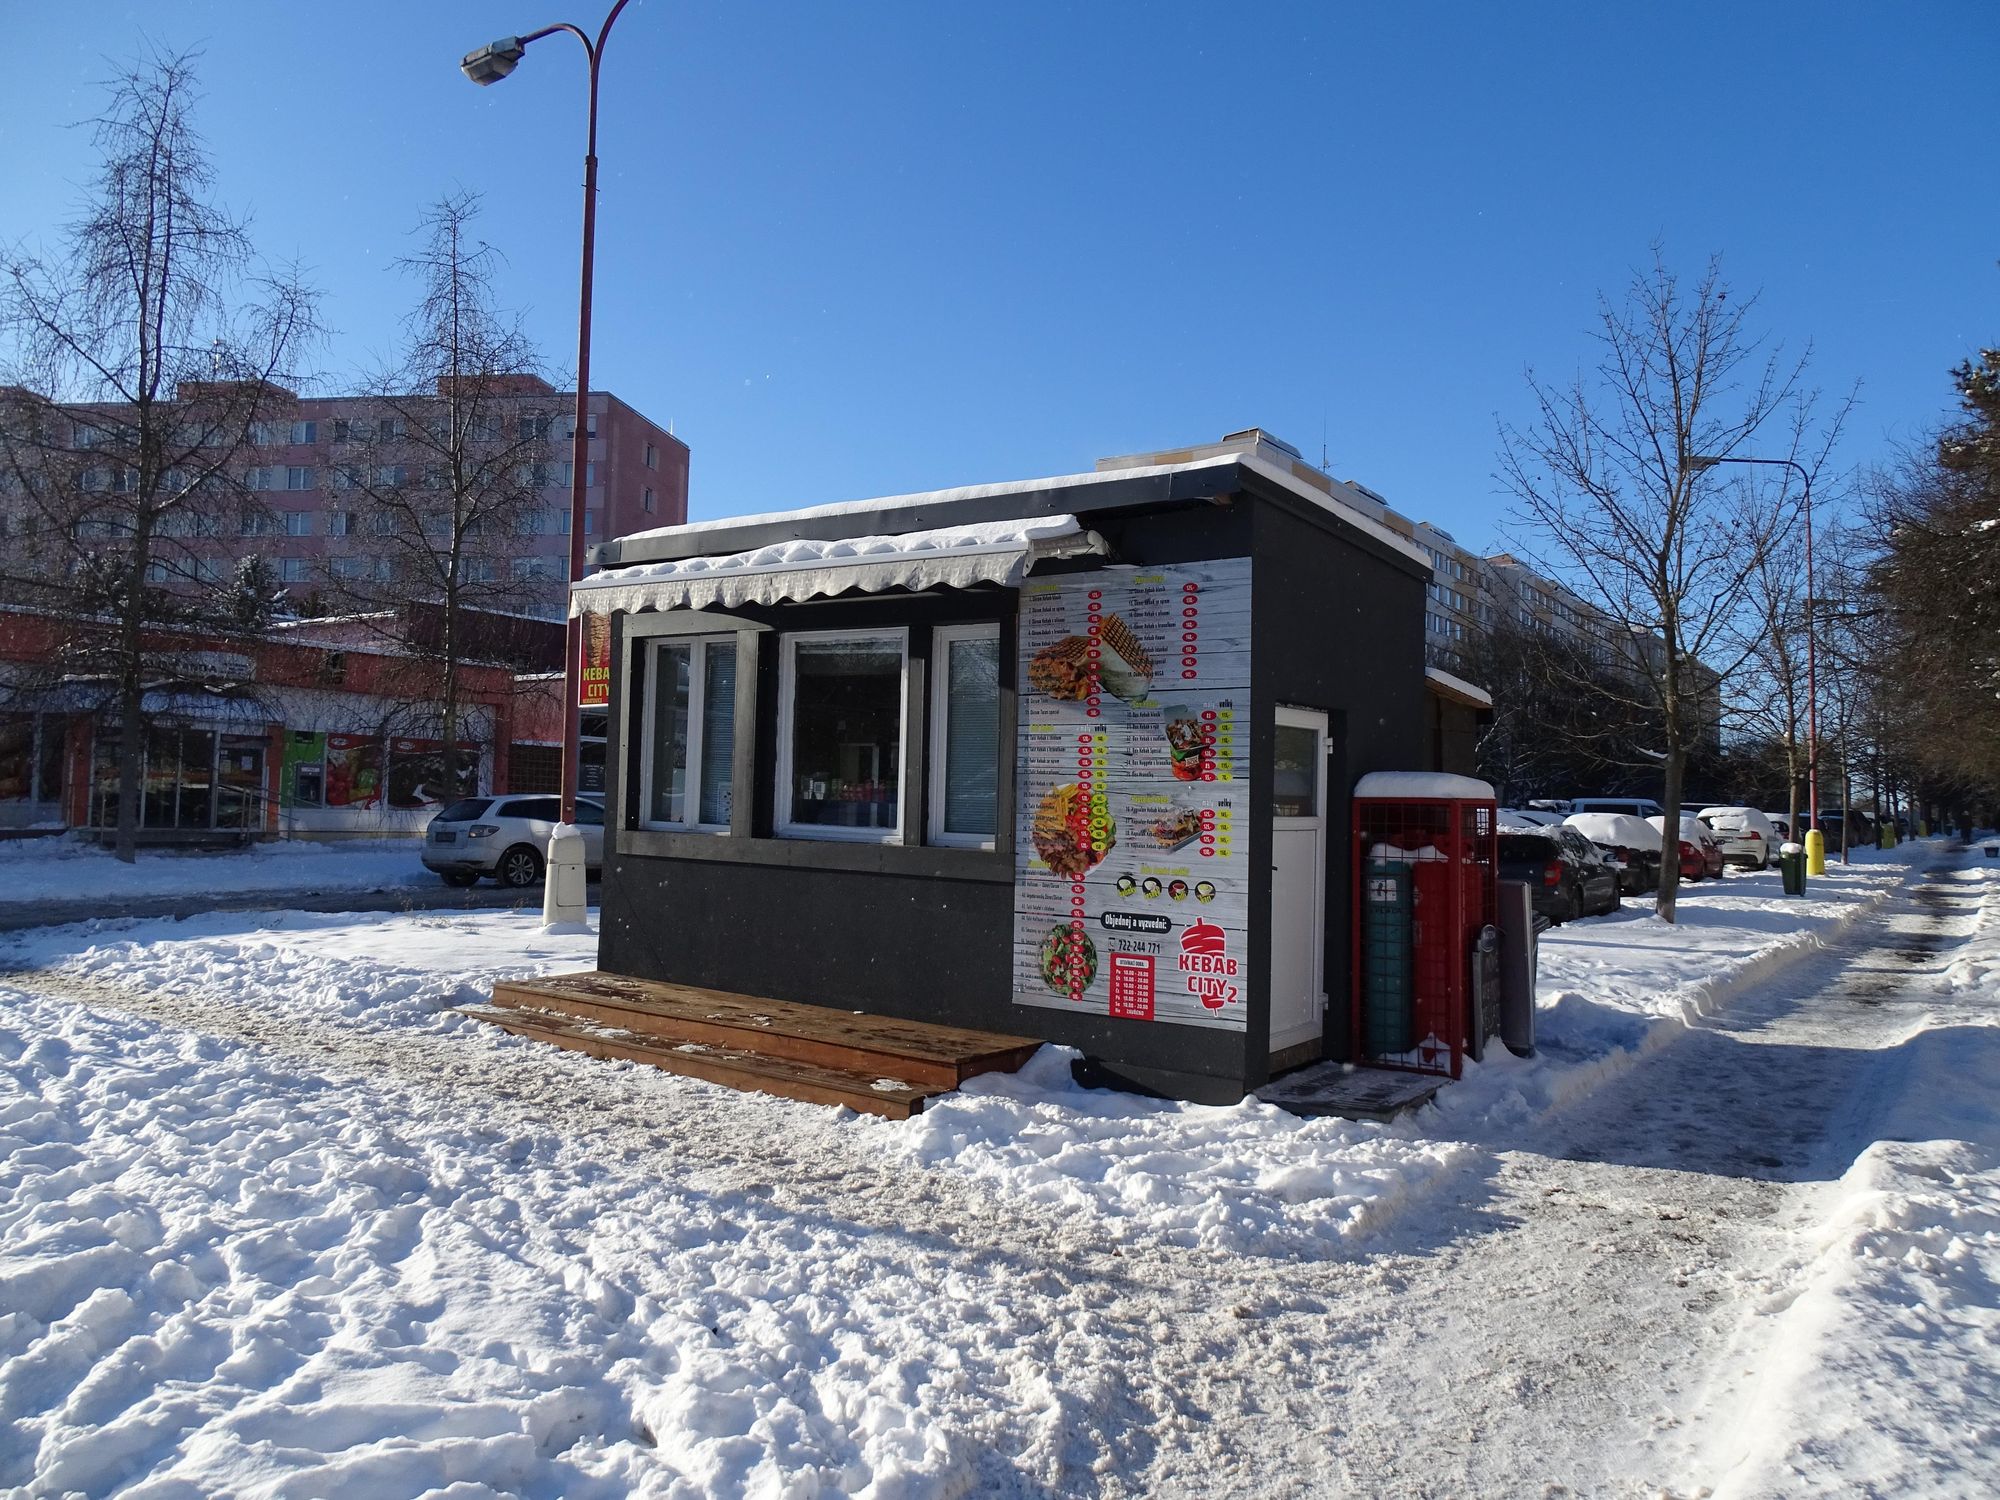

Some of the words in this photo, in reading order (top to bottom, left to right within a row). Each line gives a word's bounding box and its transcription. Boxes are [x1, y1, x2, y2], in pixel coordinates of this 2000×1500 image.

[583, 667, 610, 681] KEBA
[588, 683, 610, 697] CITY
[1218, 798, 1232, 809] velký
[1105, 913, 1132, 929] Objednej
[1132, 919, 1137, 927] a
[1118, 939, 1131, 952] 722
[1132, 941, 1146, 953] 244
[1148, 943, 1160, 954] 771
[1179, 954, 1237, 976] KEBAB
[1188, 976, 1227, 995] CITY
[1228, 987, 1238, 1003] 2
